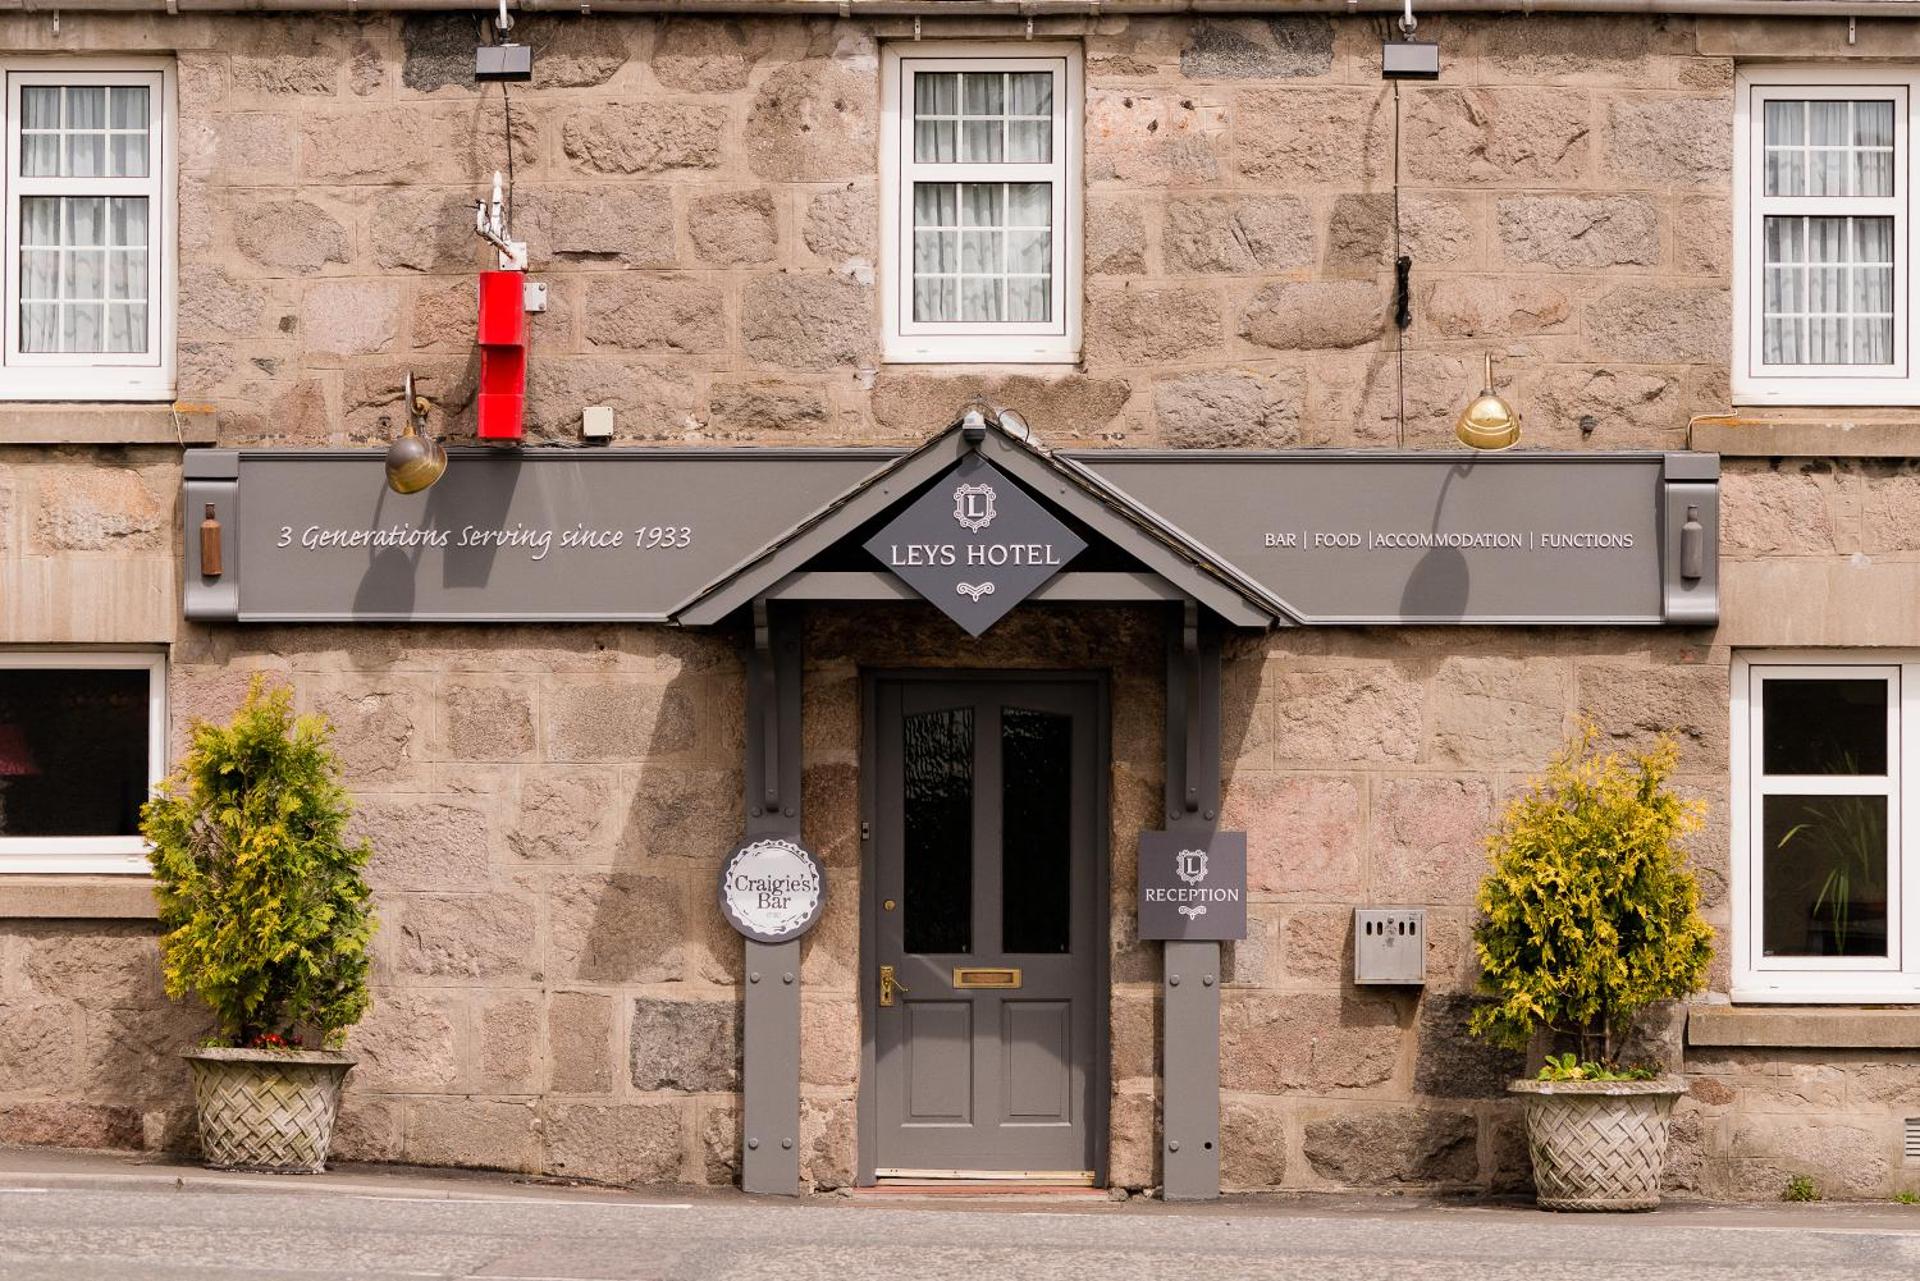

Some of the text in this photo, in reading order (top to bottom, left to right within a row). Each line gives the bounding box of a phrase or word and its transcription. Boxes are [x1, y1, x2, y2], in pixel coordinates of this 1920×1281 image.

[968, 494, 985, 517] L
[278, 523, 692, 560] 3 Generations Serving since 1933
[1265, 533, 1633, 548] BAR FOOD ACCOMMODATION FUNCTIONS
[890, 544, 1061, 566] LEYS HOTEL
[1186, 857, 1200, 875] L
[734, 874, 811, 896] Craigie's
[1145, 888, 1239, 902] RECEPTION
[758, 892, 791, 909] Bar
